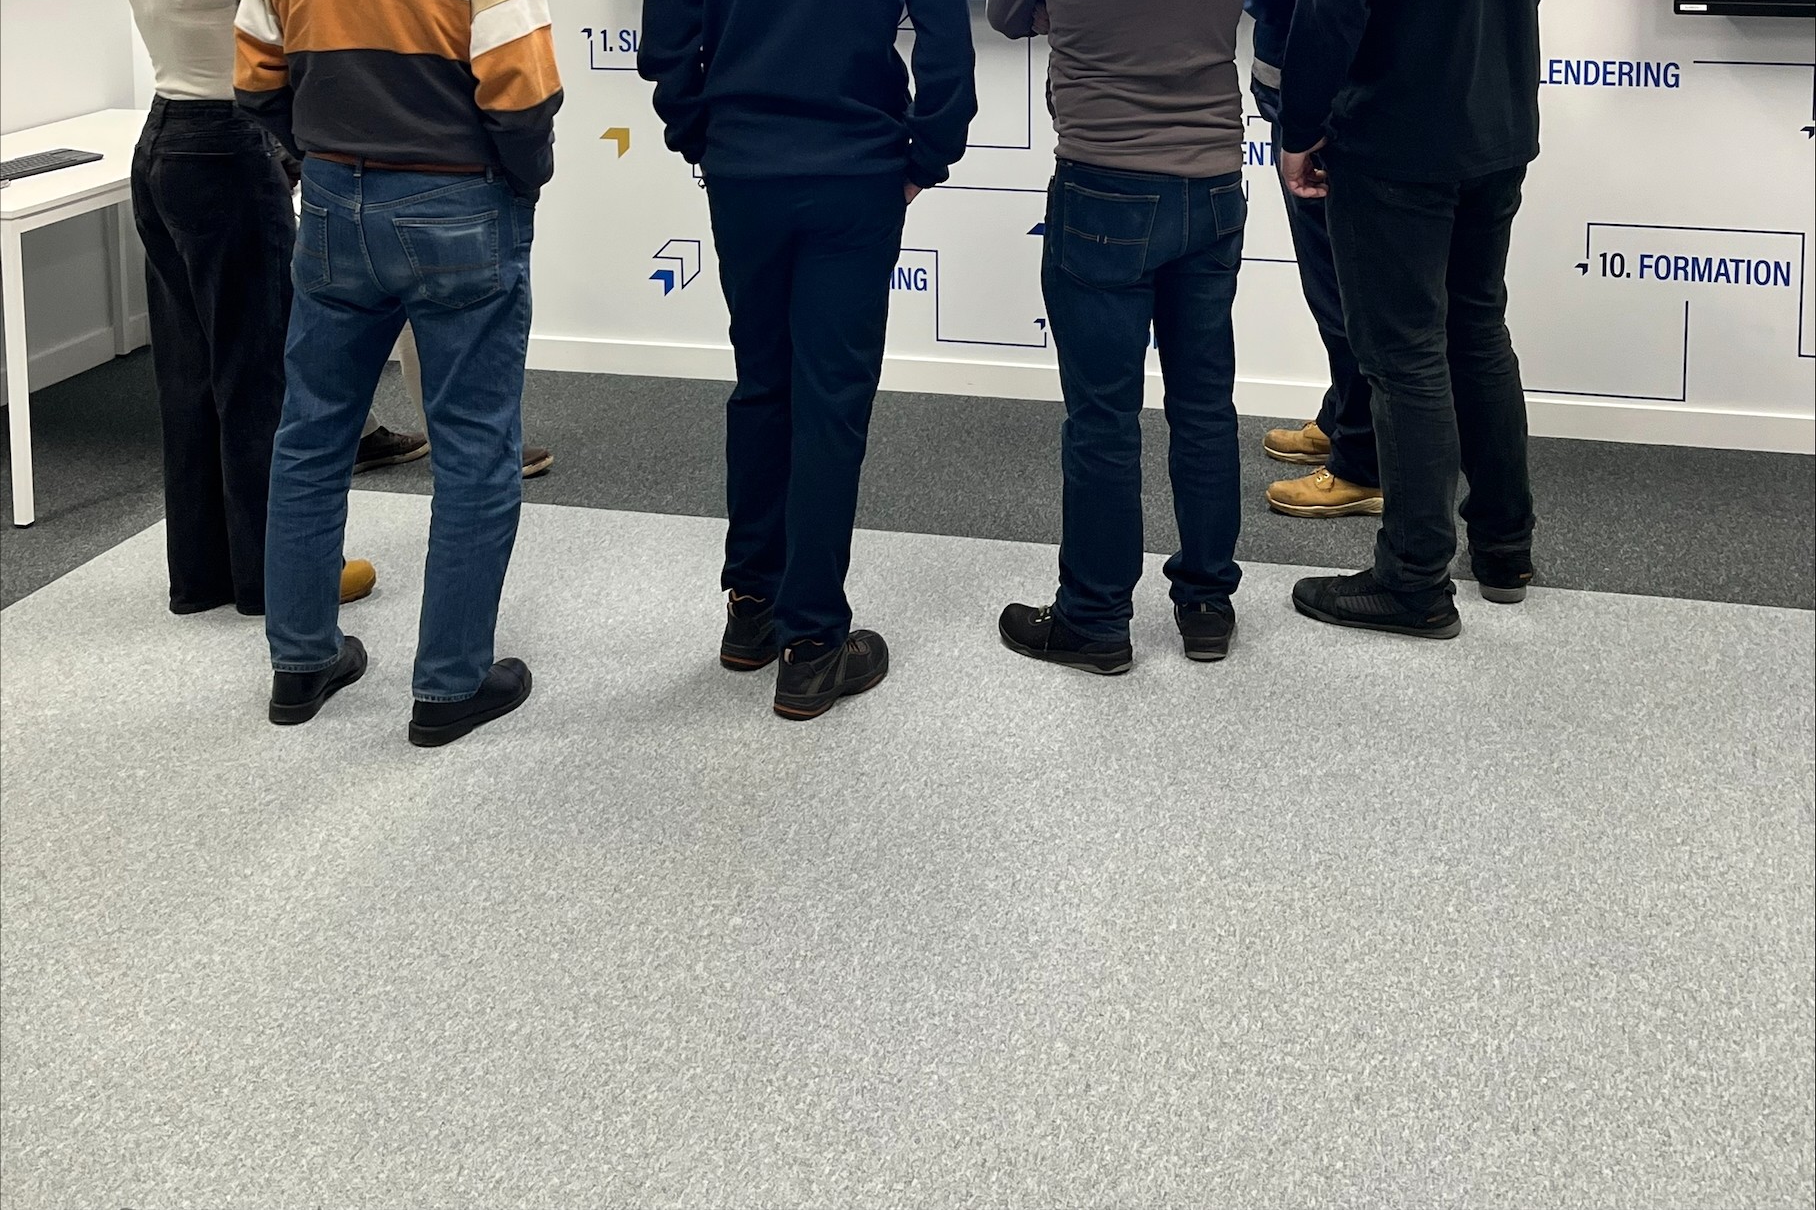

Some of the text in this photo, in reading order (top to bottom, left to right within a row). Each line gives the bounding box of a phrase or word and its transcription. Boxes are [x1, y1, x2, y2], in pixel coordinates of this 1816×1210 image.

[600, 29, 639, 52] 1. SL
[1540, 59, 1680, 88] ENDERING
[890, 267, 928, 291] ING
[1599, 252, 1791, 287] 10. FORMATION
